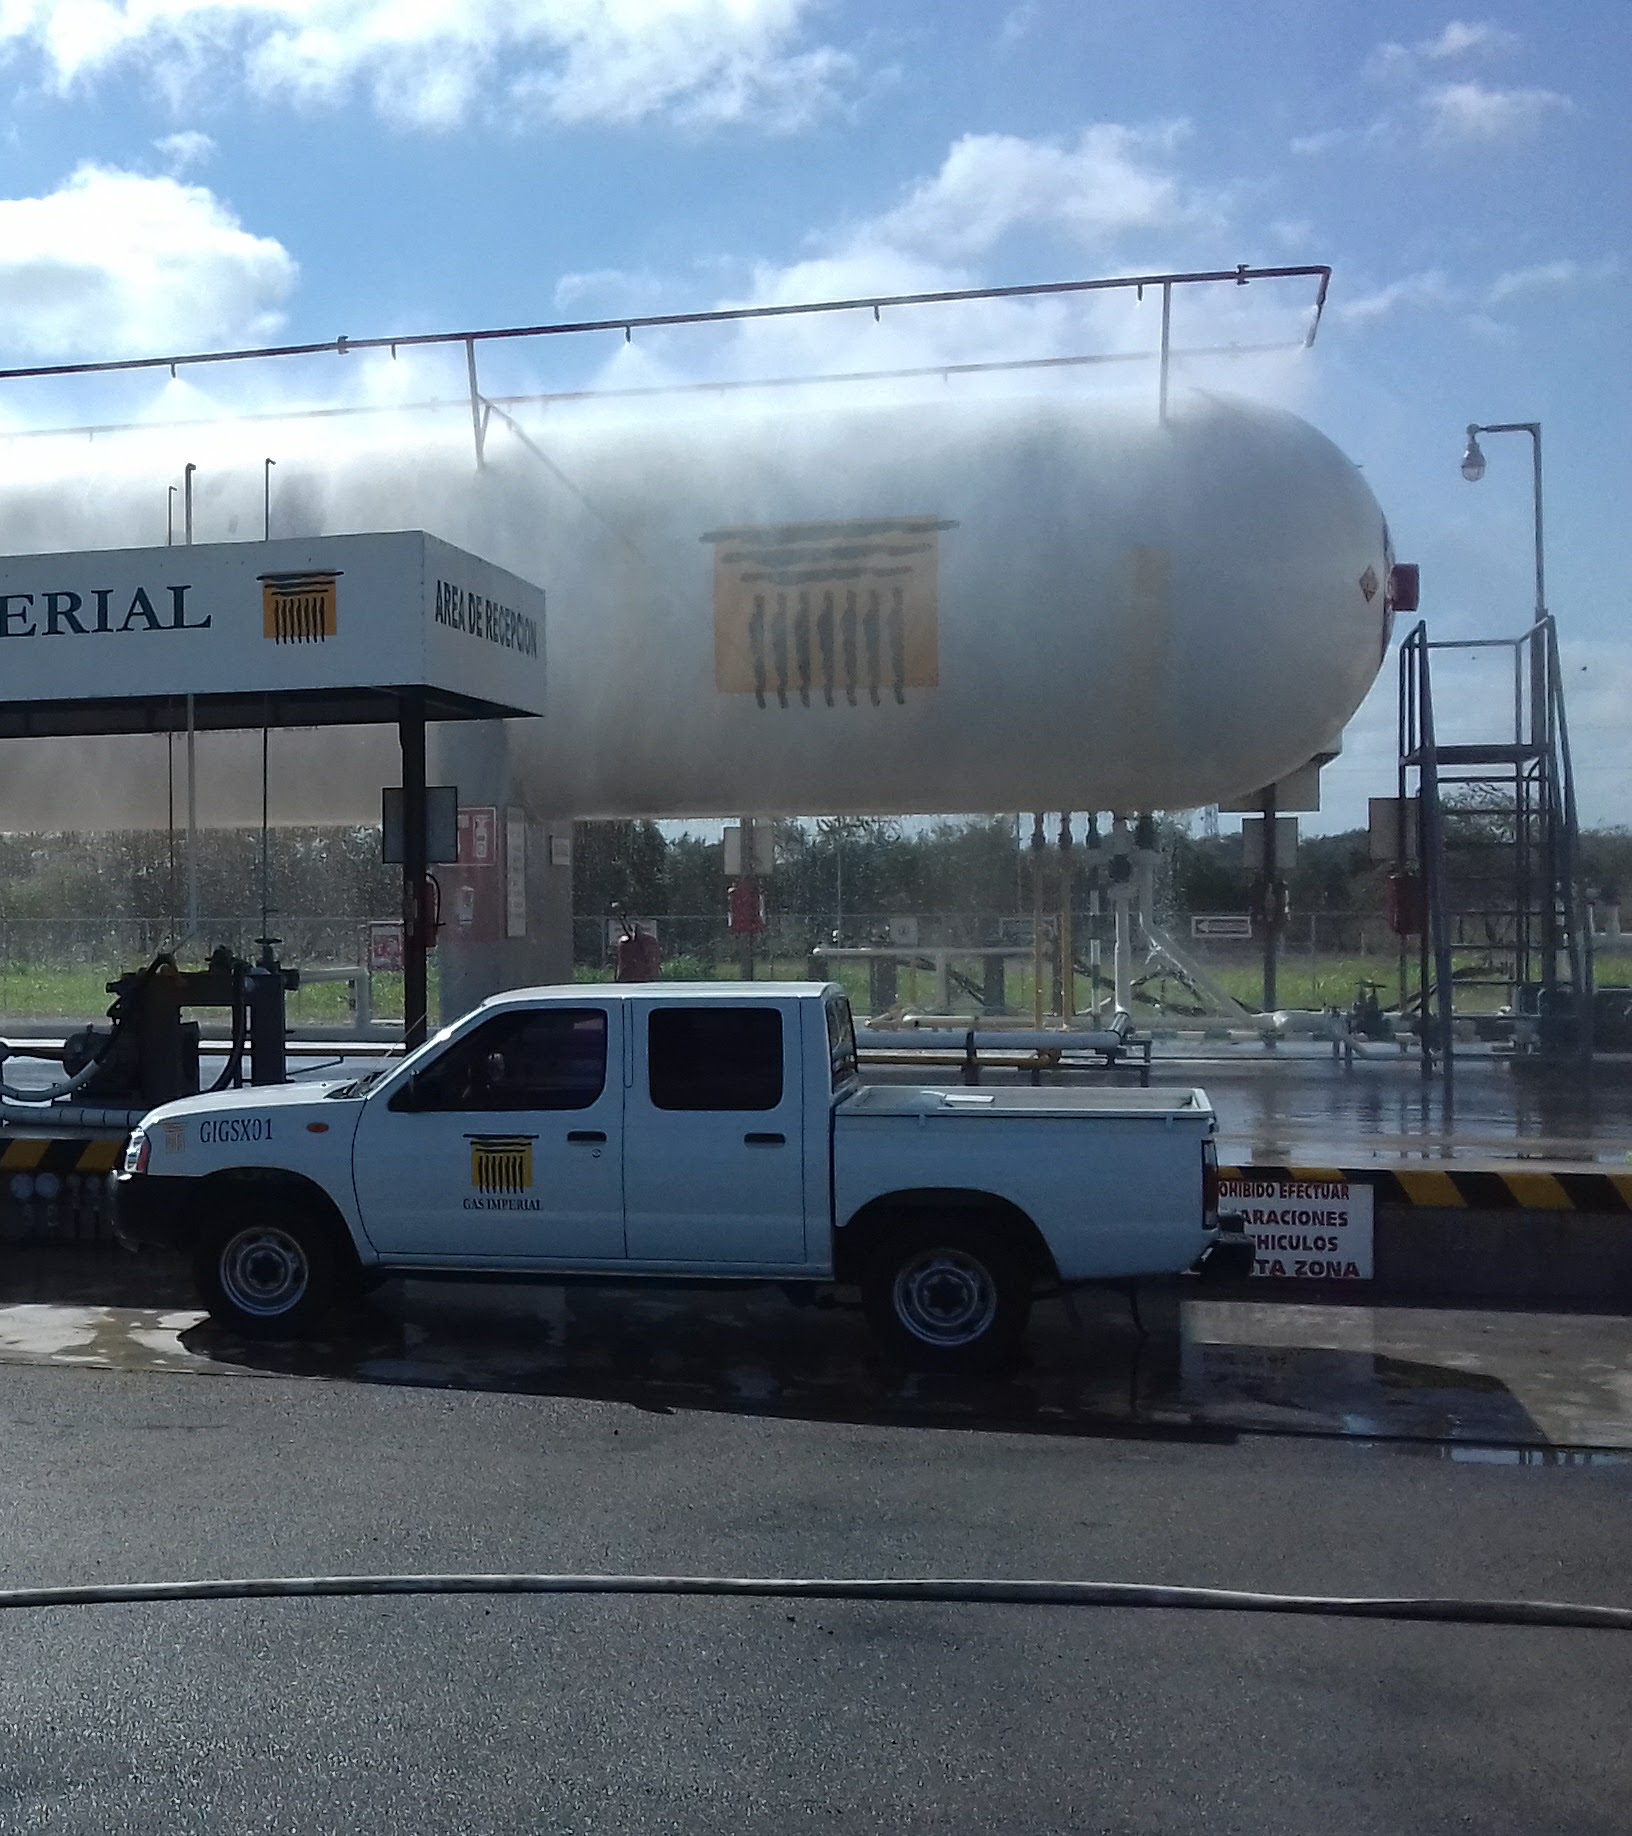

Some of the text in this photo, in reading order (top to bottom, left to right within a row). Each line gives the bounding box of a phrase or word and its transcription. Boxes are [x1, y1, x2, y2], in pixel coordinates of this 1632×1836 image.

[435, 580, 537, 660] AREA DE RECEPCION
[200, 1118, 273, 1143] GIGSX01
[1219, 1183, 1350, 1200] OHIBIDO EFECTUAR
[462, 1198, 543, 1211] GAS IMPERIAL
[1241, 1210, 1349, 1227] ARACIONES
[1253, 1235, 1338, 1252] HICULOS
[1294, 1260, 1361, 1278] ZONA
